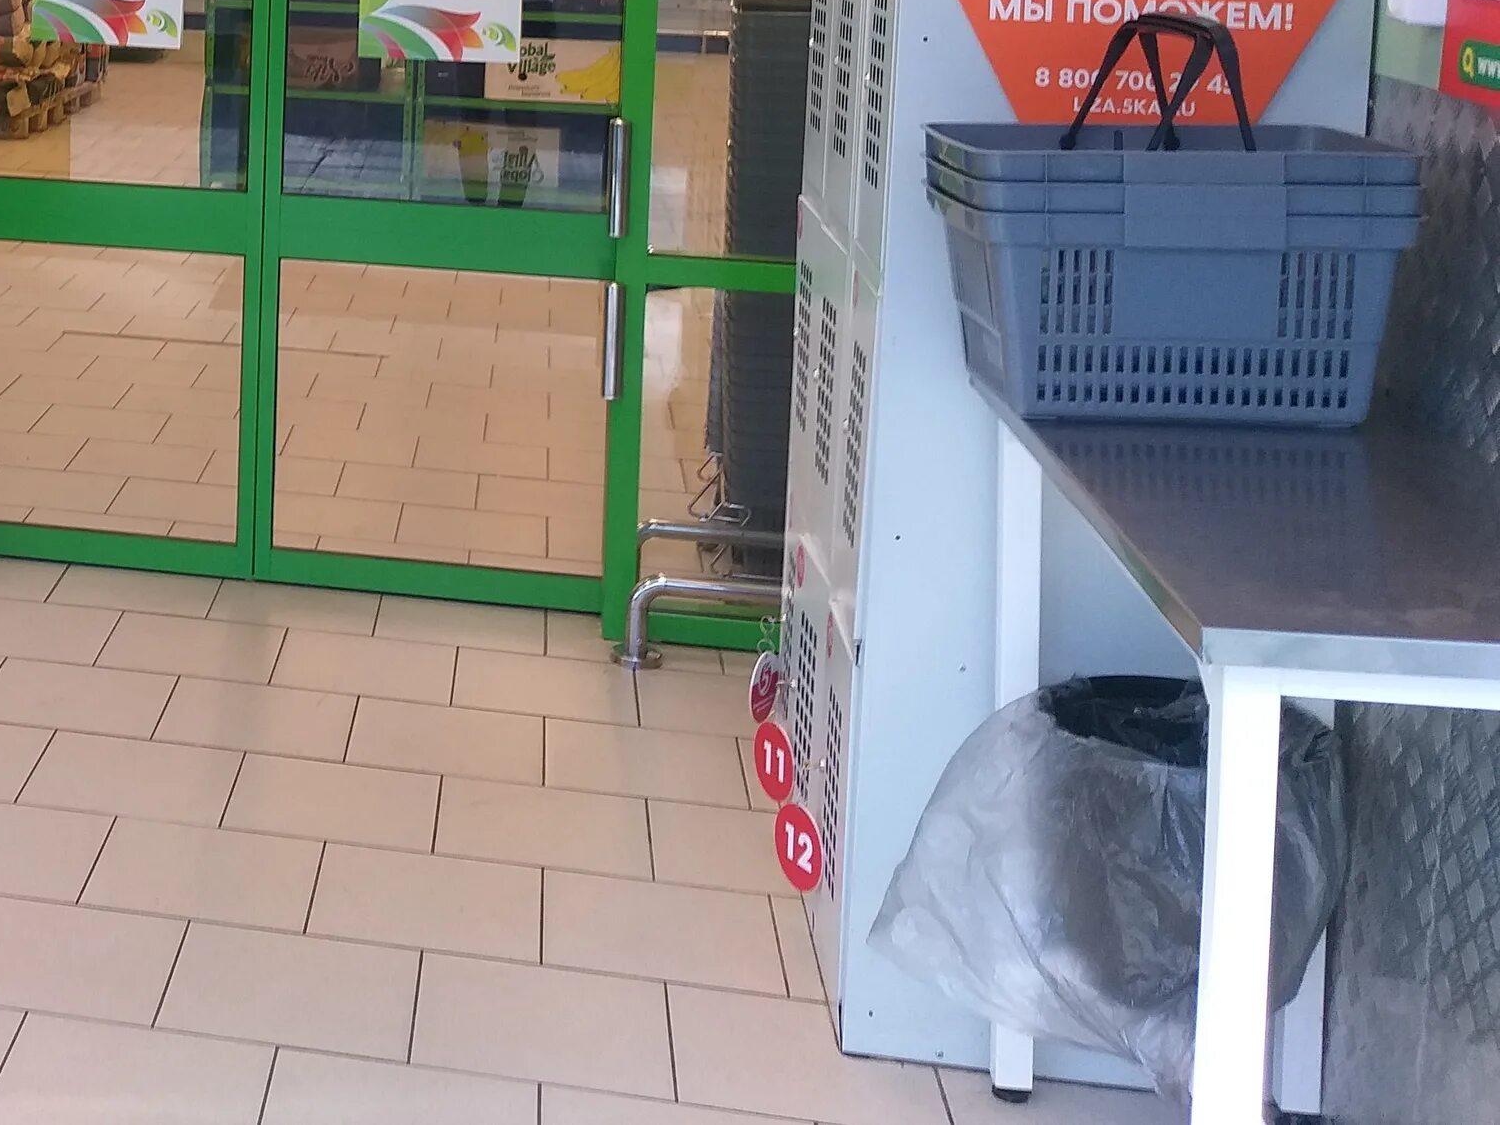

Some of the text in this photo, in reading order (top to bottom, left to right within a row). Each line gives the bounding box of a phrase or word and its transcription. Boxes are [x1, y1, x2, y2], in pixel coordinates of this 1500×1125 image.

[520, 41, 555, 59] obal
[1035, 66, 1050, 88] 8
[762, 738, 785, 784] 11
[784, 819, 814, 875] 12
